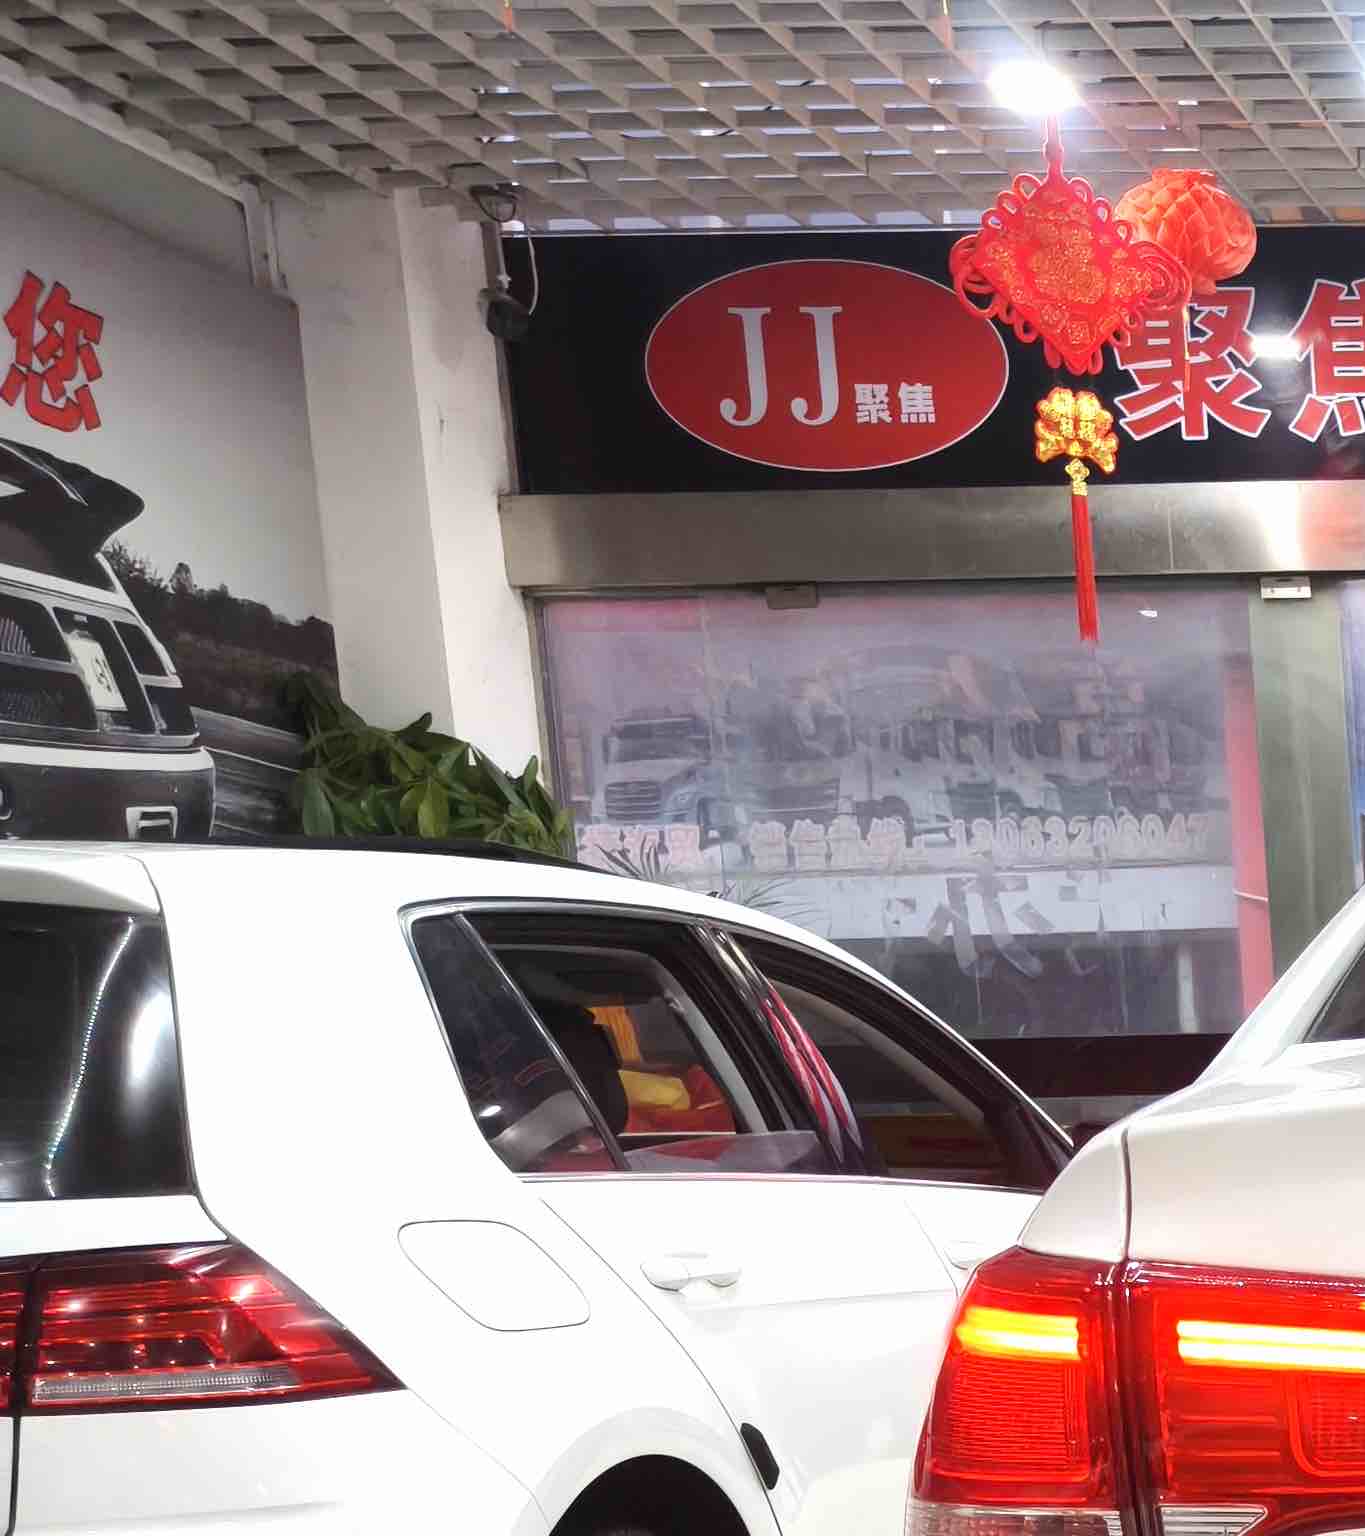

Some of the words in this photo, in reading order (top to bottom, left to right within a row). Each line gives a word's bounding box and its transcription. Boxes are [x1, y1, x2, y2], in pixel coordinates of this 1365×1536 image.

[0, 269, 104, 433] 您
[719, 306, 843, 427] JJ
[853, 383, 937, 425] 聚焦
